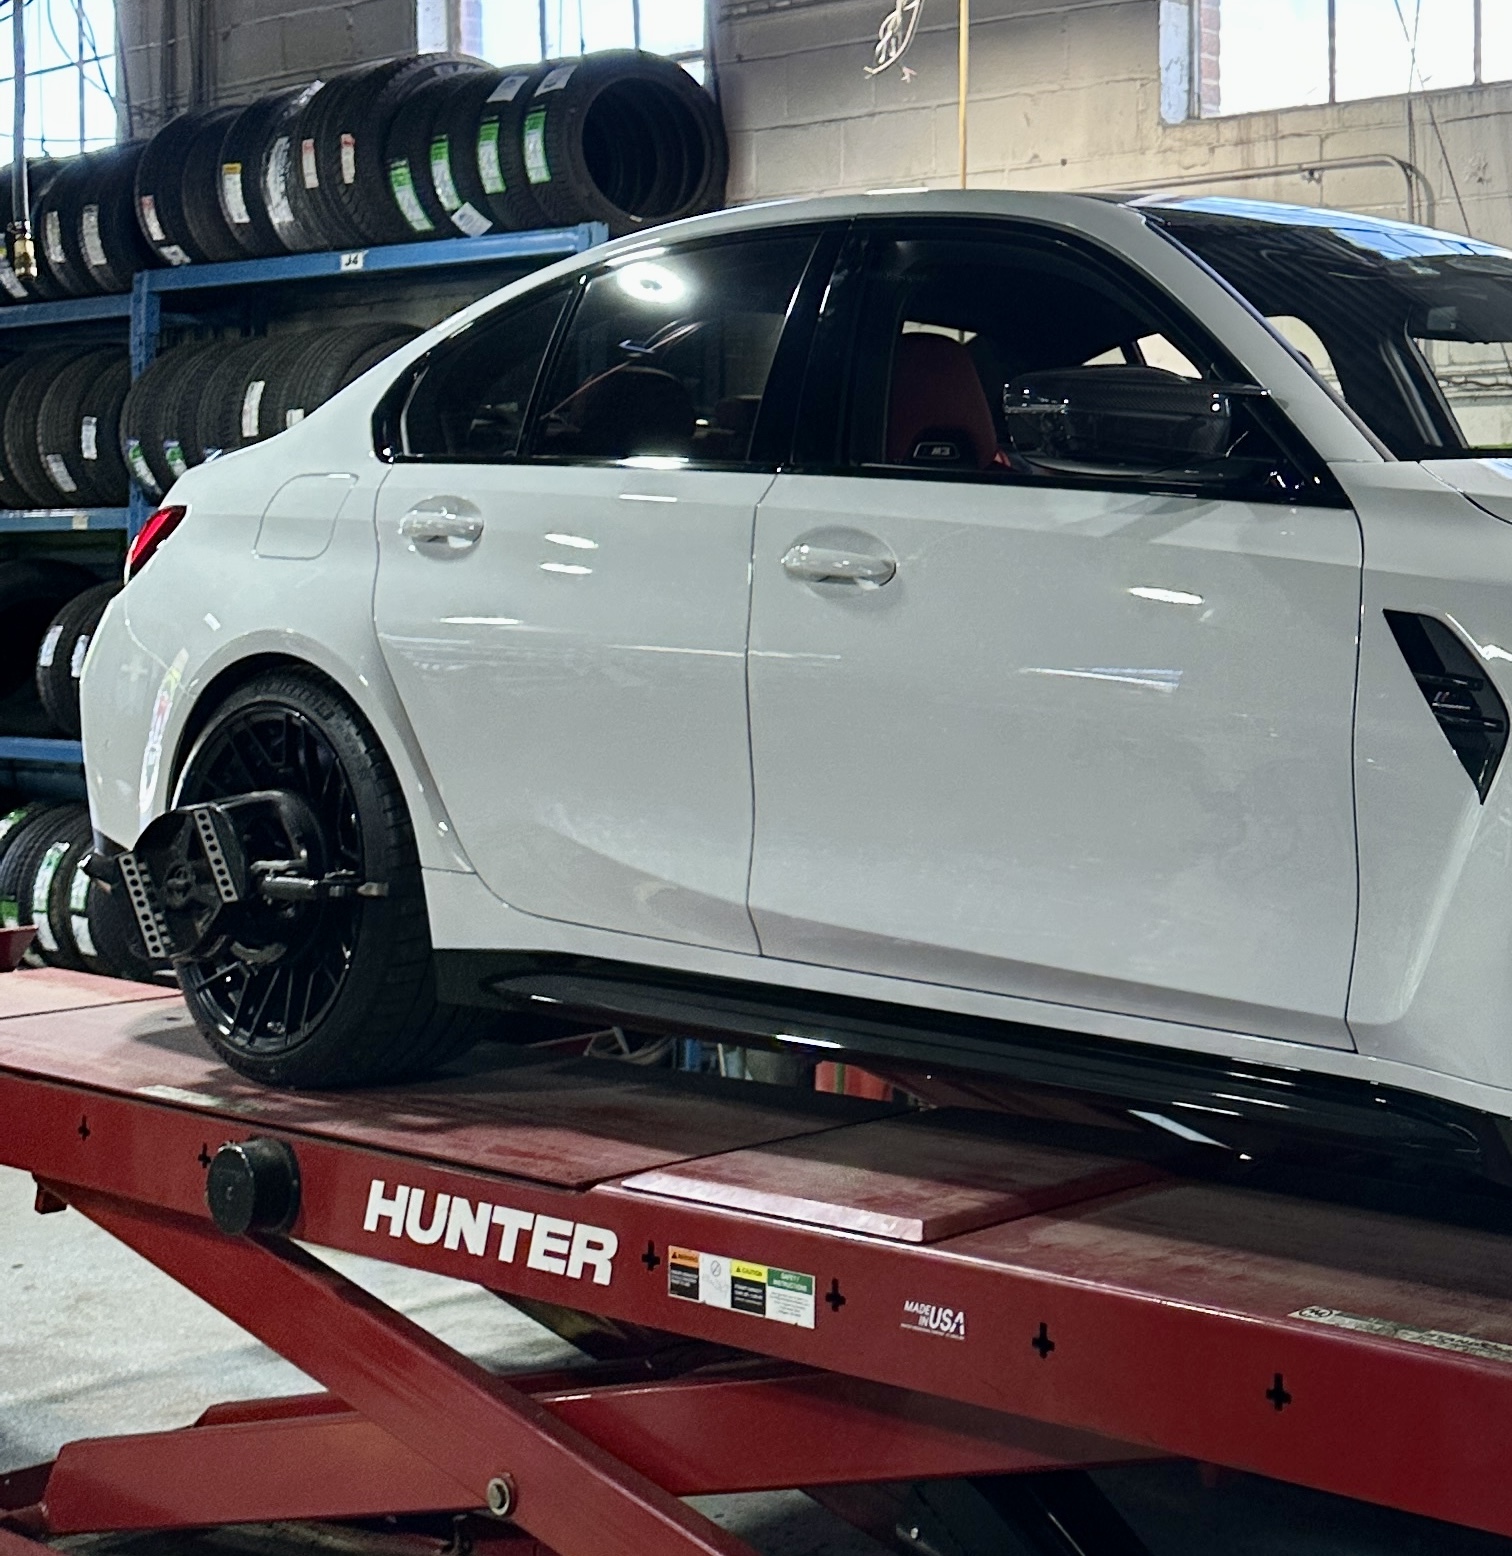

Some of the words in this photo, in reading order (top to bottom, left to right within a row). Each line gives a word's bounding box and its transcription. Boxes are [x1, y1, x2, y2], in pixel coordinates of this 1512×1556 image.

[363, 1179, 619, 1286] HUNTER
[904, 1300, 931, 1315] MADE
[918, 1315, 929, 1327] IN
[929, 1306, 965, 1335] USA
